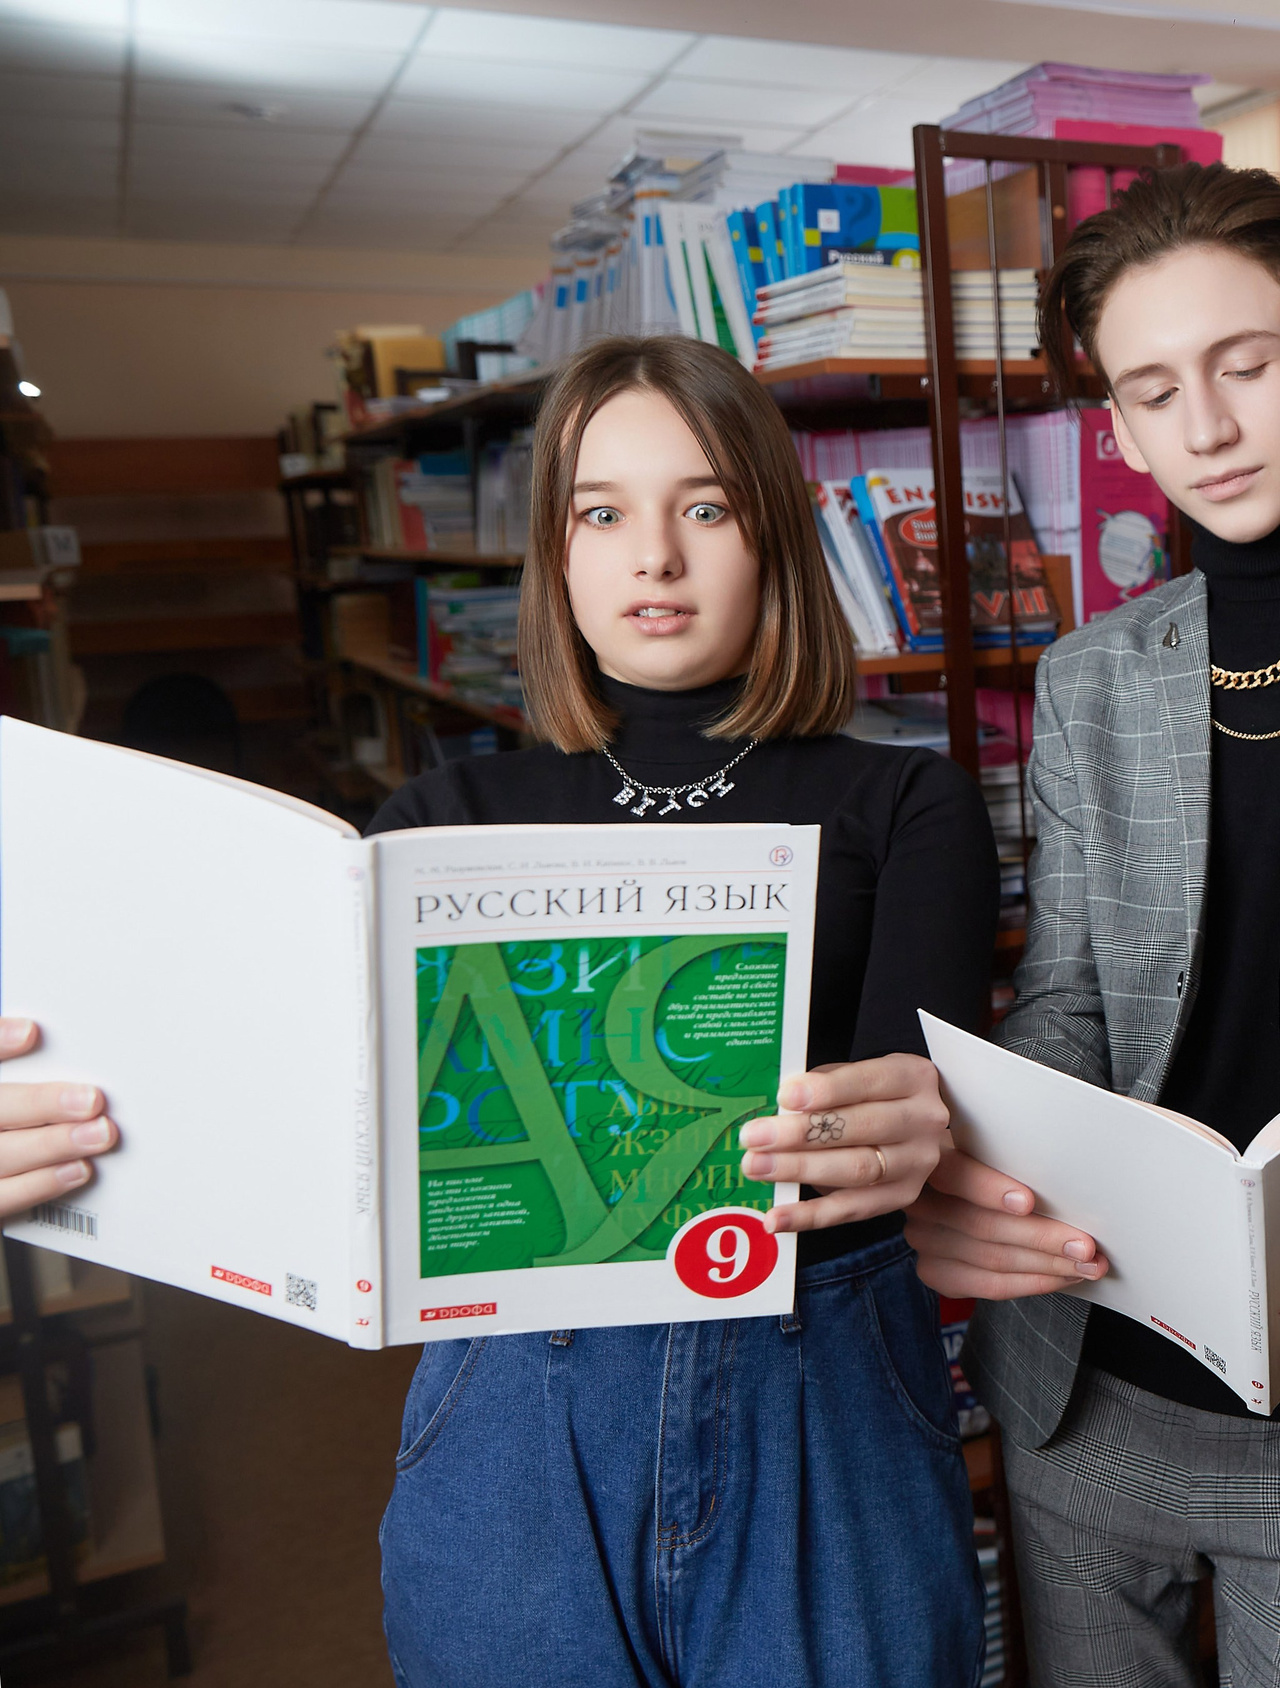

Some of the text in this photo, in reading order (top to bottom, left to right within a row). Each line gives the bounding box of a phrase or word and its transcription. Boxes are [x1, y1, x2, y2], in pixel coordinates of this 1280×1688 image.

[886, 486, 1012, 508] ENISH
[612, 777, 735, 818] BITCH
[414, 879, 790, 923] РУССКИЙ ЯЗЫК
[706, 1224, 753, 1284] 9
